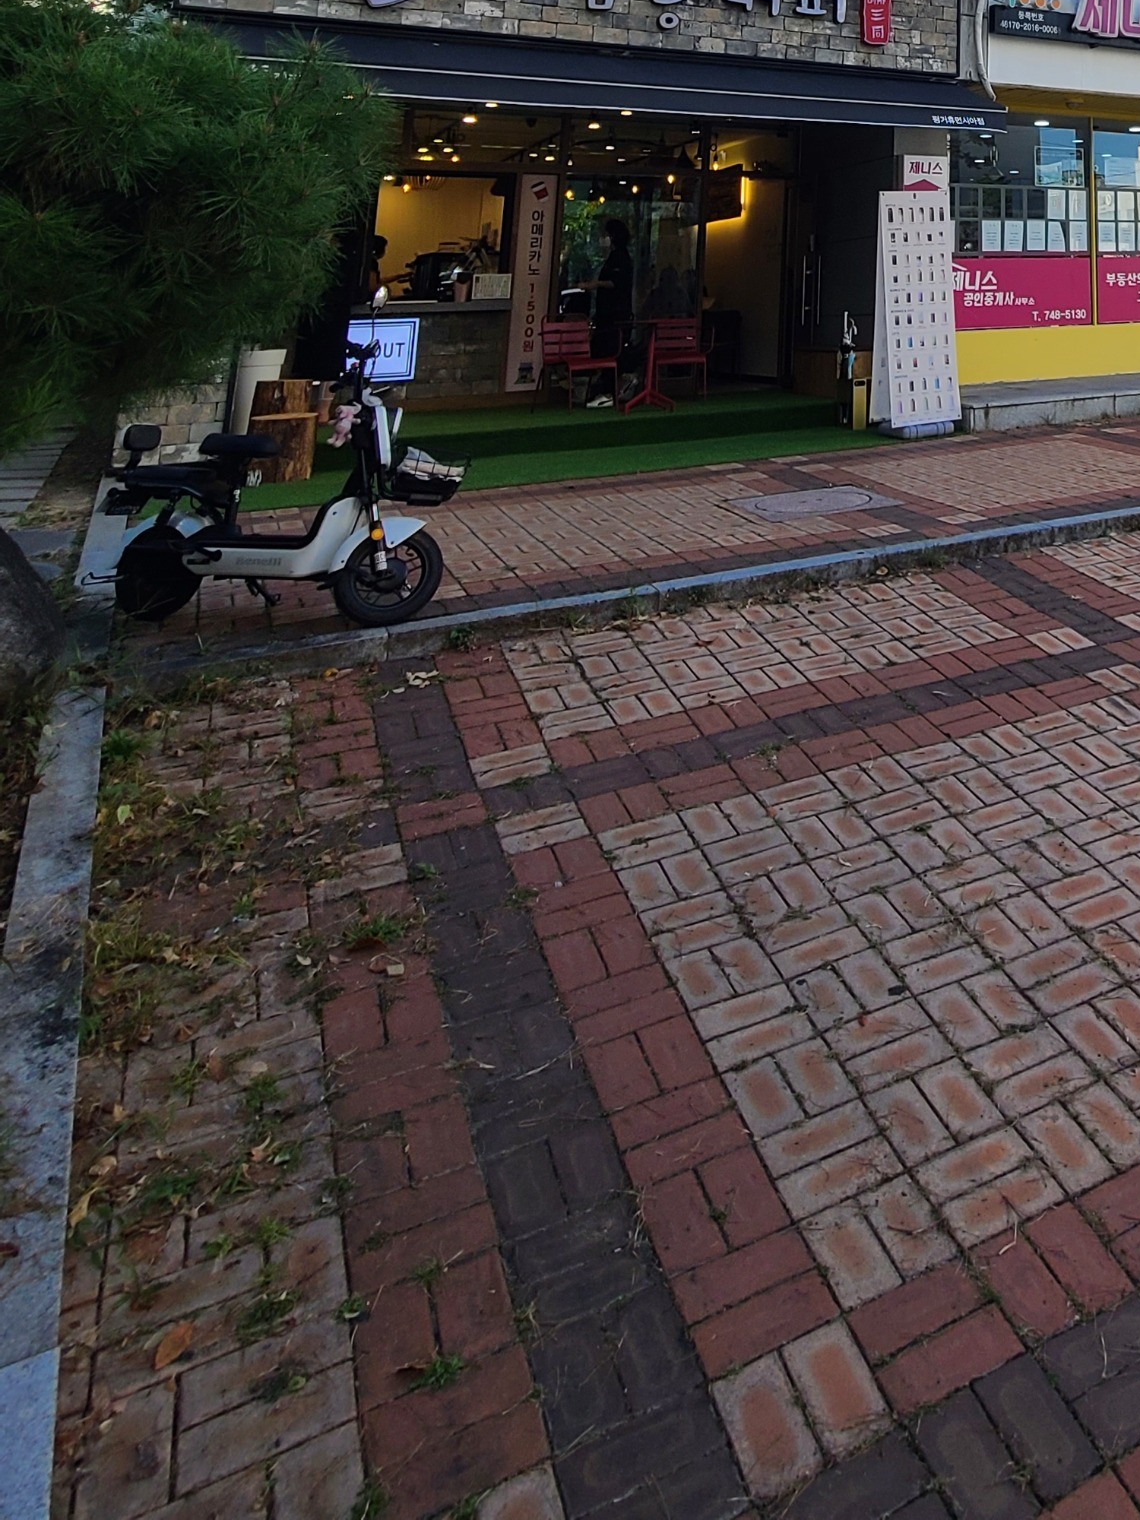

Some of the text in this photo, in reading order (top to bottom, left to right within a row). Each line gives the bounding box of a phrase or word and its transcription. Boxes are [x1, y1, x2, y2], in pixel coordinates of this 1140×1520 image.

[1018, 10, 1045, 22] 등록번호
[909, 160, 943, 175] 제니스
[527, 209, 545, 277] 아메리카노
[963, 291, 1015, 307] 공인중개사
[1043, 308, 1087, 321] 748-5130
